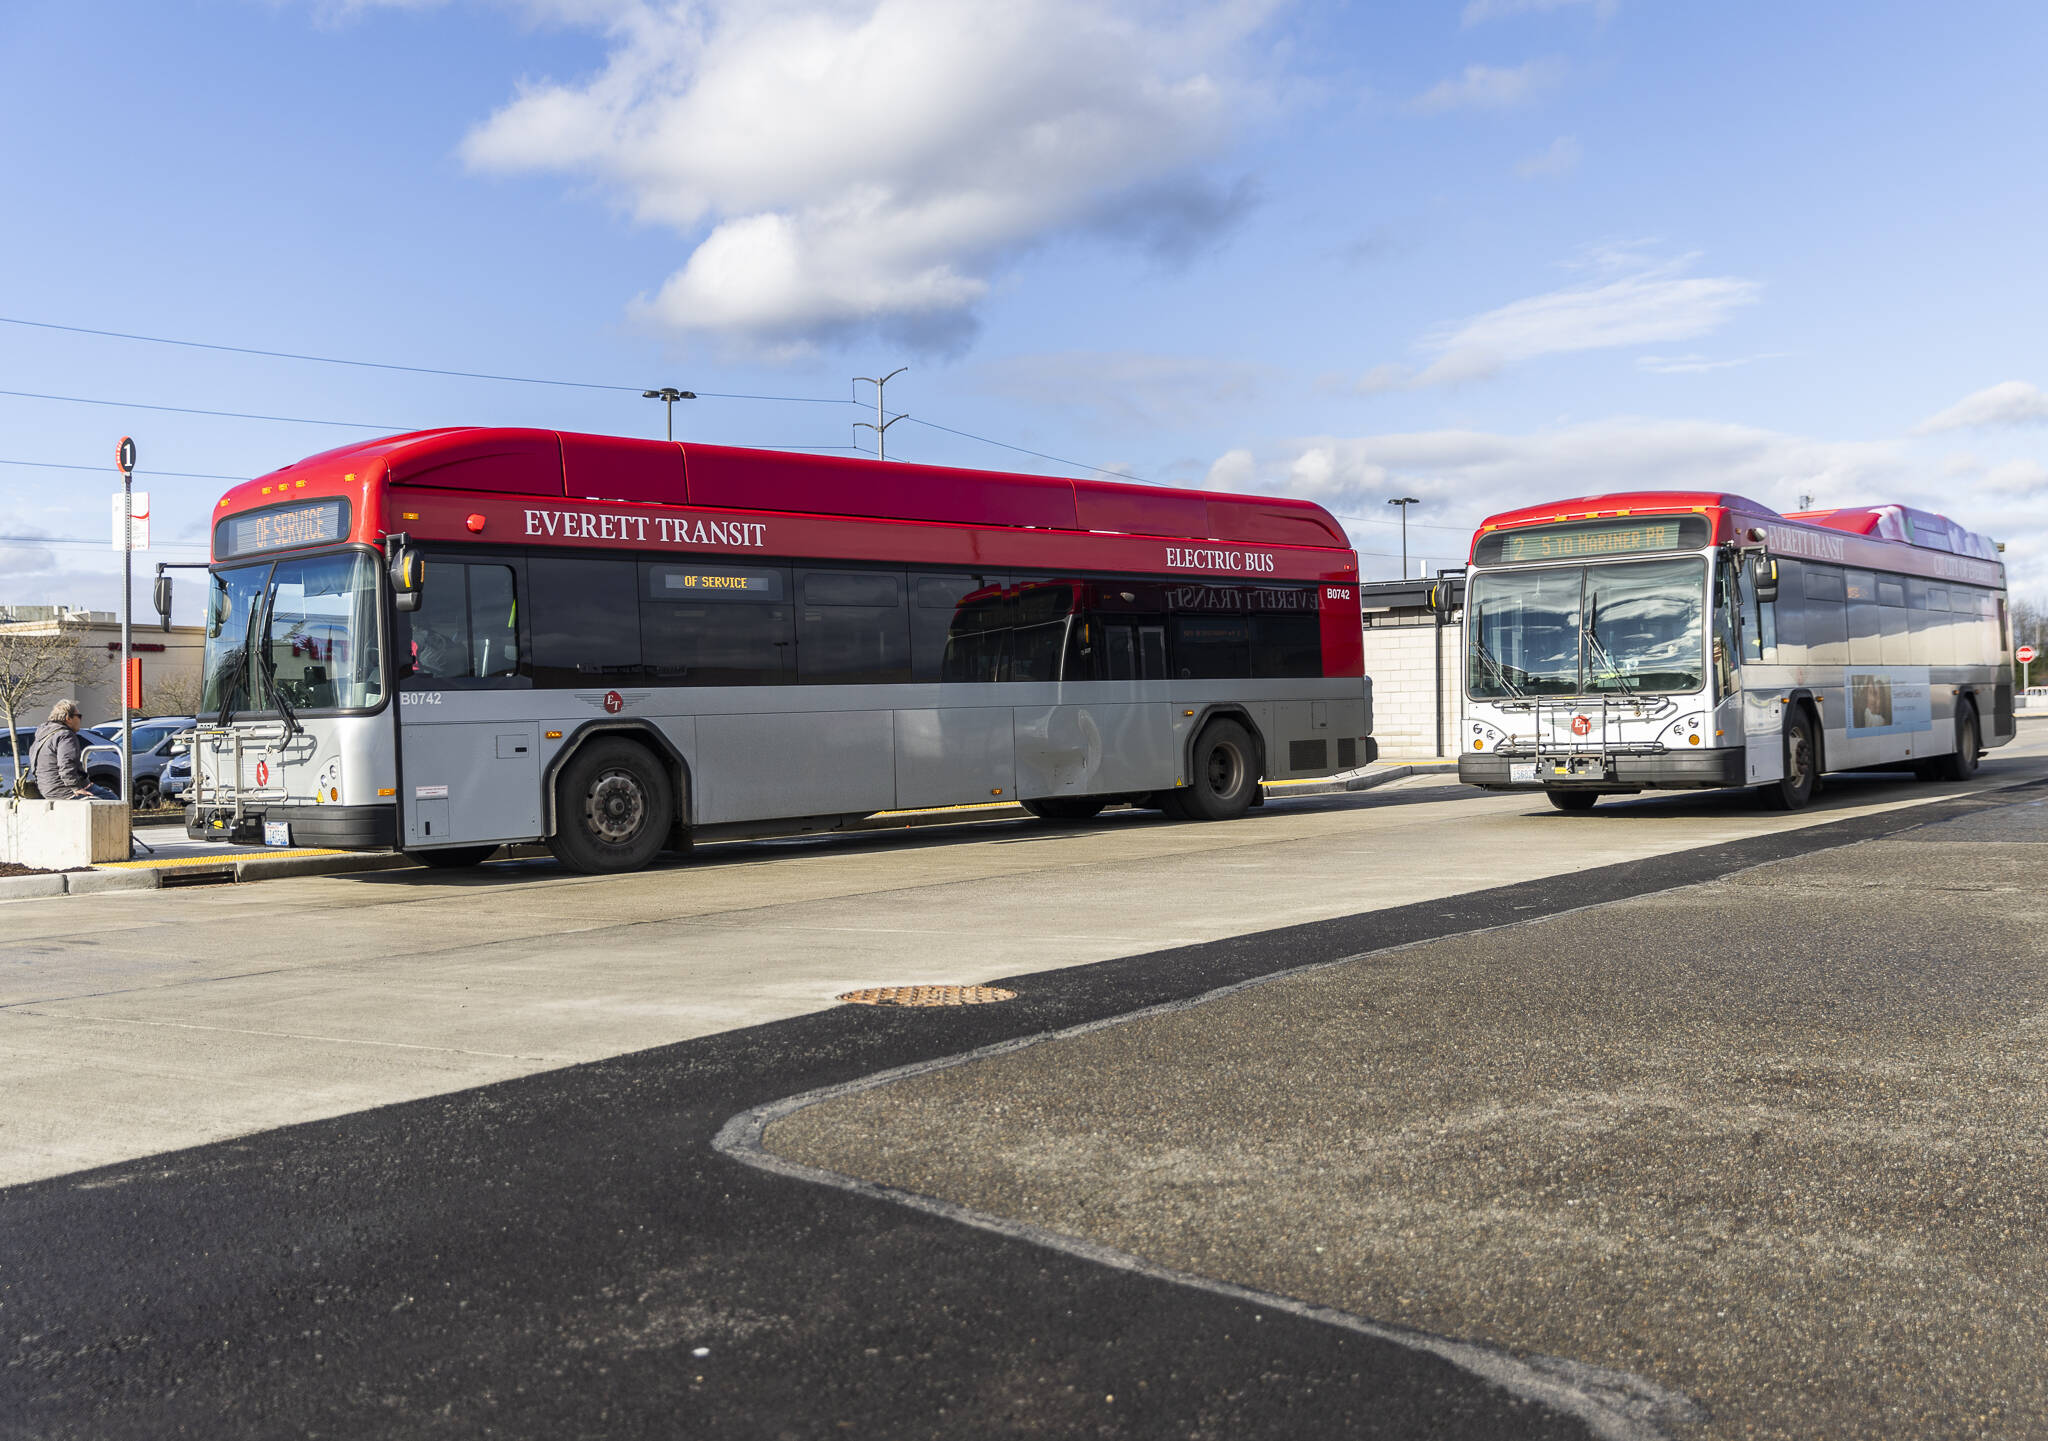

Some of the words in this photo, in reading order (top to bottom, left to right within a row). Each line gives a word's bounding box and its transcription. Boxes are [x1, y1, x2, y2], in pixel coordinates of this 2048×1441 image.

[124, 444, 132, 466] 1
[257, 517, 271, 547] OF
[273, 507, 325, 545] SERVICE
[524, 509, 649, 541] EVERETT
[655, 517, 766, 547] TRANSIT
[1513, 537, 1526, 561] 2
[1541, 536, 1551, 556] S
[1646, 527, 1665, 548] PR
[1768, 525, 1808, 554] EVERETT
[1808, 533, 1844, 561] TRANSIT
[1166, 547, 1241, 571] ELECTRIC
[1244, 553, 1274, 572] BUS
[684, 575, 698, 588] OF
[702, 576, 748, 589] SERVICE
[1327, 588, 1350, 600] B0742
[401, 693, 442, 705] B0742
[606, 694, 620, 711] ET
[1574, 718, 1588, 734] ET
